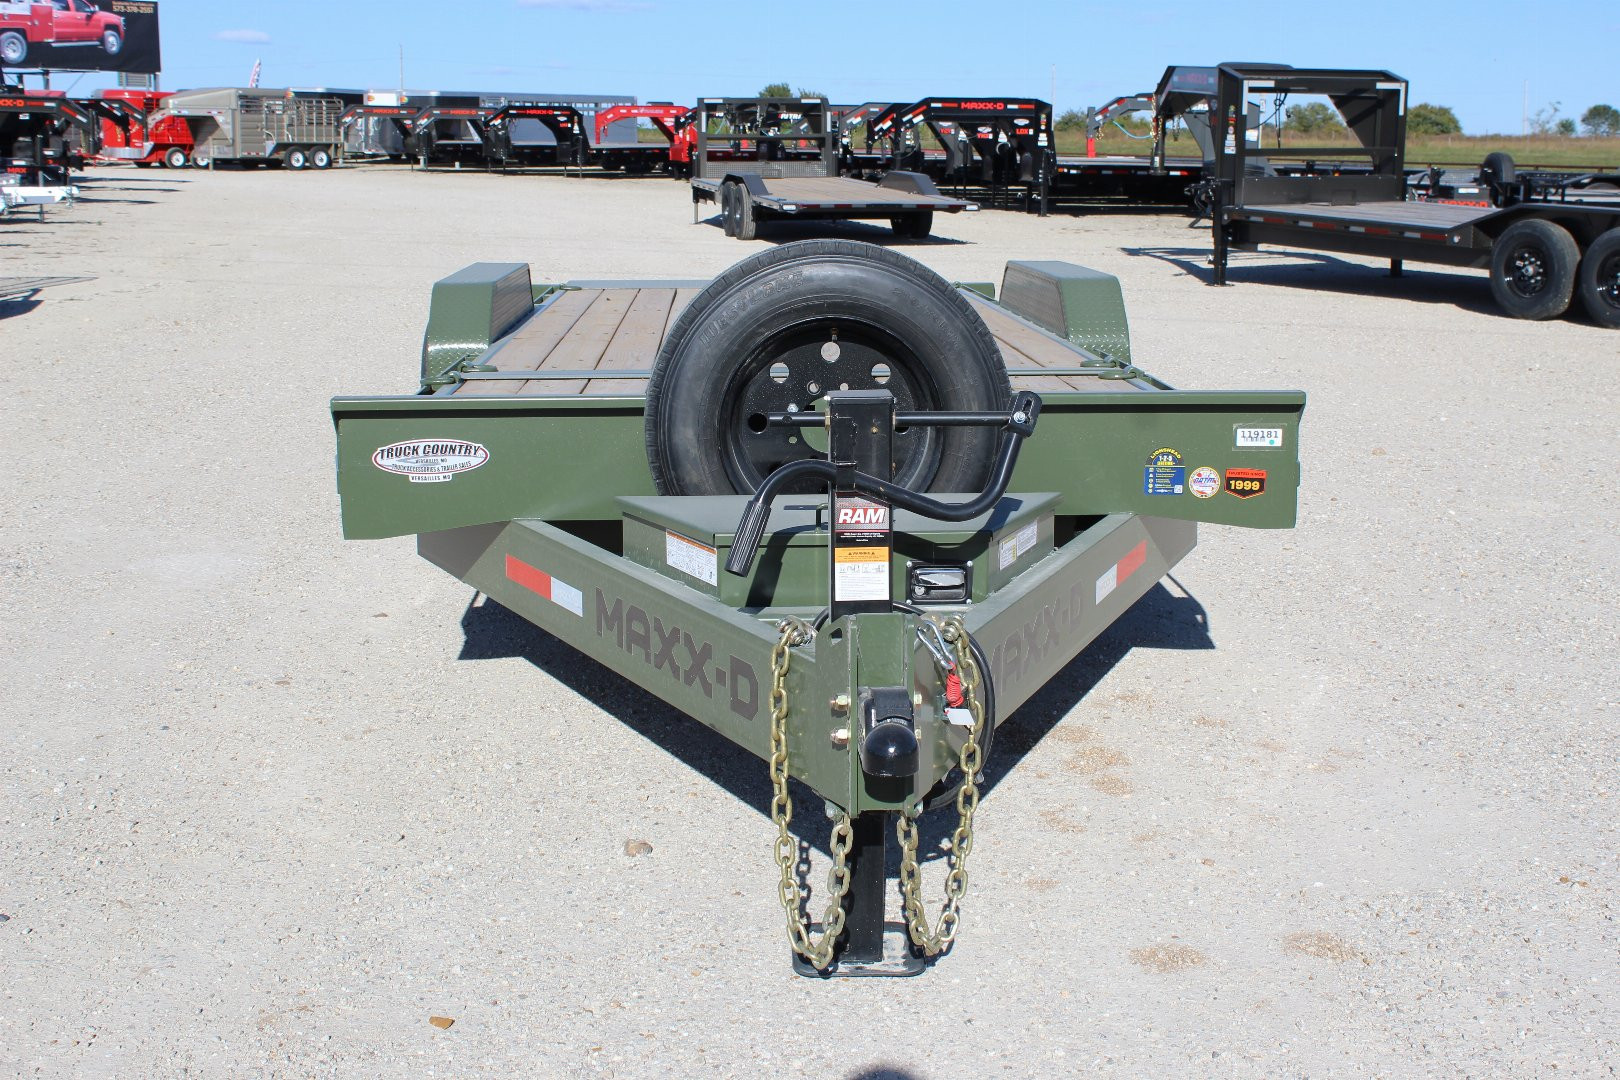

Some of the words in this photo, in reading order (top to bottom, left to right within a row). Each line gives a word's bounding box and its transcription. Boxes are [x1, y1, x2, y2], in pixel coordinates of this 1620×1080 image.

[961, 102, 1005, 110] MAXX-D
[1241, 430, 1279, 439] 119181
[379, 445, 420, 460] TRUCK
[422, 444, 481, 456] COUNTRY
[406, 465, 437, 473] ACCESSORIES
[441, 464, 458, 472] TRAILER
[458, 461, 472, 469] SALES
[1229, 480, 1260, 491] 1999
[838, 508, 886, 524] RAM
[596, 586, 759, 721] MAXX-D
